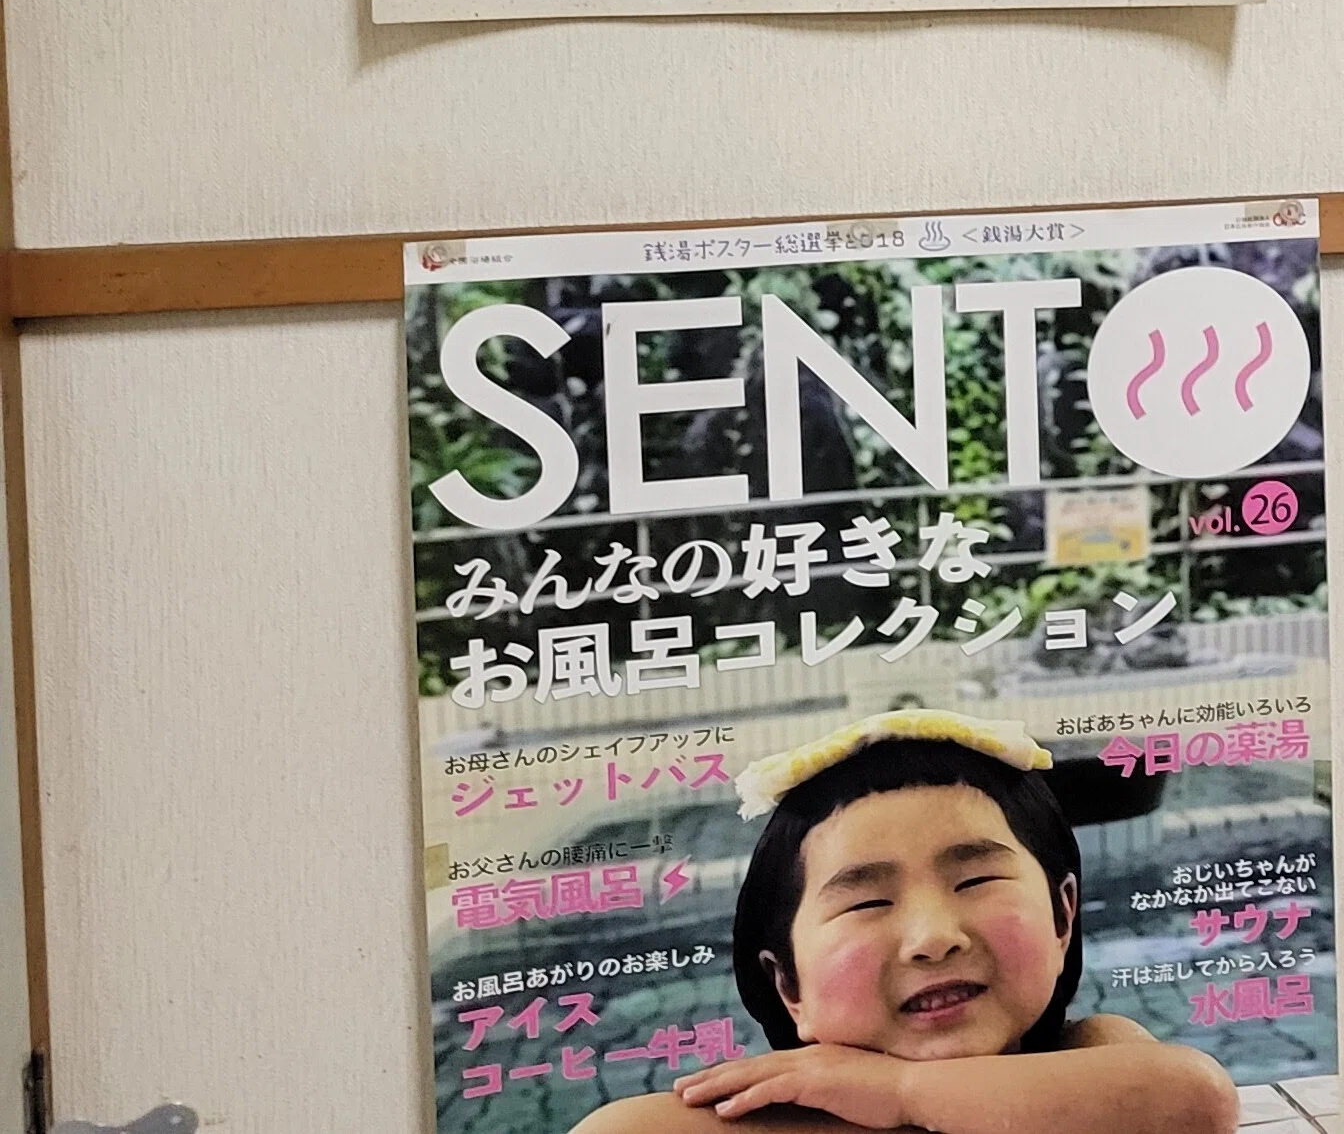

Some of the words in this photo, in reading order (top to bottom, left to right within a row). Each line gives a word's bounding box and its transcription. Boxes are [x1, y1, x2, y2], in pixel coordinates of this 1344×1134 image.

[1189, 506, 1241, 535] vol.
[1250, 491, 1292, 526] 26
[445, 511, 991, 622] みんなの好きな
[448, 588, 1178, 710] お風呂コレクション
[1055, 695, 1313, 736] おばあちゃんに効能いろいろ
[444, 725, 736, 775] お母さんのシェイプアップに
[1098, 718, 1313, 779] 今日の薬湯
[450, 752, 731, 817] ジェットバス
[447, 833, 675, 881] お父さんの腰痛に一撃
[1172, 852, 1317, 887] おじいちゃんが
[451, 863, 646, 931] 電気風呂
[1130, 874, 1317, 912] なかなか出てこない
[1188, 900, 1312, 948] サウナ
[452, 944, 717, 1003] お風呂あがりのお楽しみ
[1111, 947, 1317, 989] 汗は流してから入ろう
[456, 991, 602, 1052] アイス
[1189, 973, 1315, 1026] 水風呂
[461, 1016, 747, 1100] コーヒー牛乳
